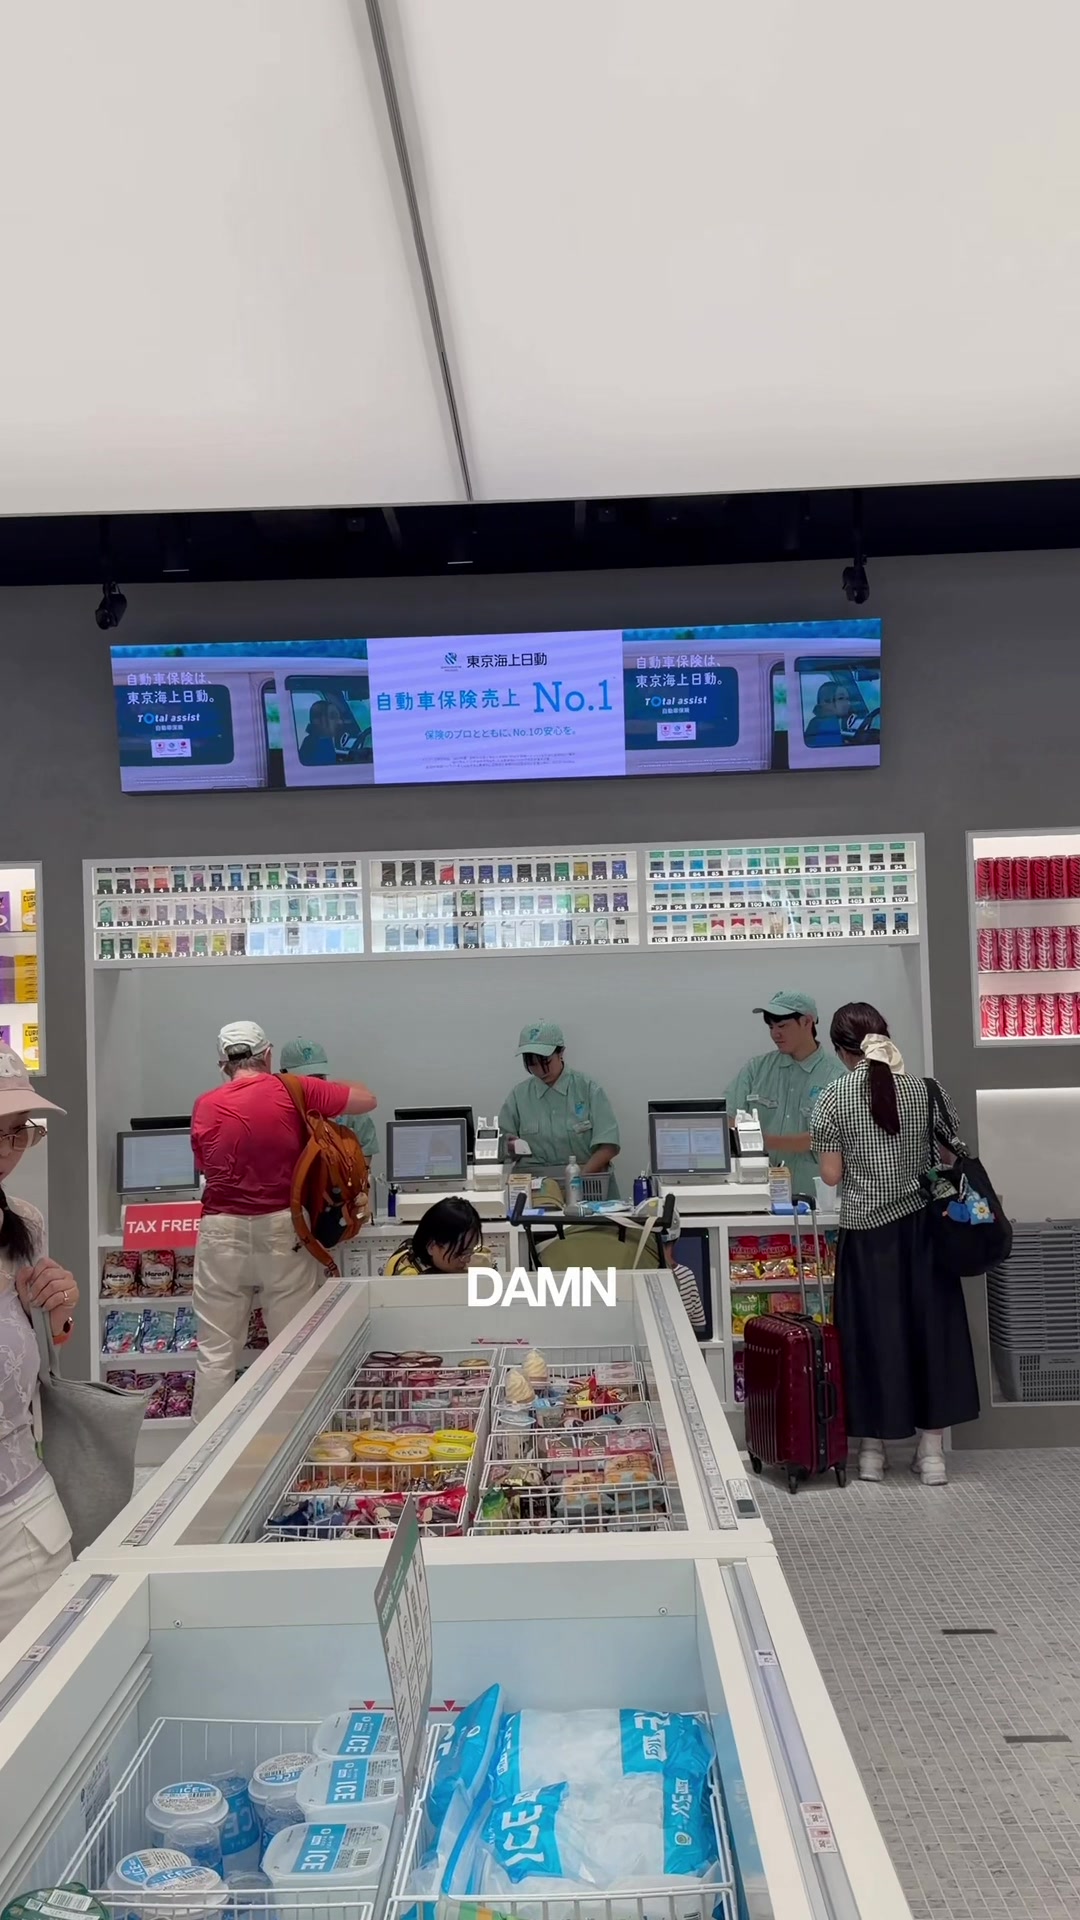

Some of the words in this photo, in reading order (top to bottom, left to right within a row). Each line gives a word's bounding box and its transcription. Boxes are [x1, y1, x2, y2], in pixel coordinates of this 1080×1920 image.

[466, 652, 547, 668] 東京海上日動
[636, 655, 721, 669] 自動車保険は、
[127, 672, 212, 686] 自動車保険は、
[636, 672, 722, 688] 東京海上日動。
[127, 690, 214, 705] 東京海上日動。
[377, 688, 520, 711] 自動車保険売上
[533, 680, 612, 713] No.1
[678, 696, 707, 705] assist
[171, 713, 200, 722] assist
[424, 725, 576, 740] 保険のプロとともに、No.1の安心を。
[126, 1220, 156, 1234] TAX
[346, 1736, 371, 1753] ICE
[646, 1738, 661, 1756] 1kg
[334, 1781, 357, 1801] ICE
[502, 1805, 544, 1866] ICE
[301, 1850, 330, 1870] ICE
